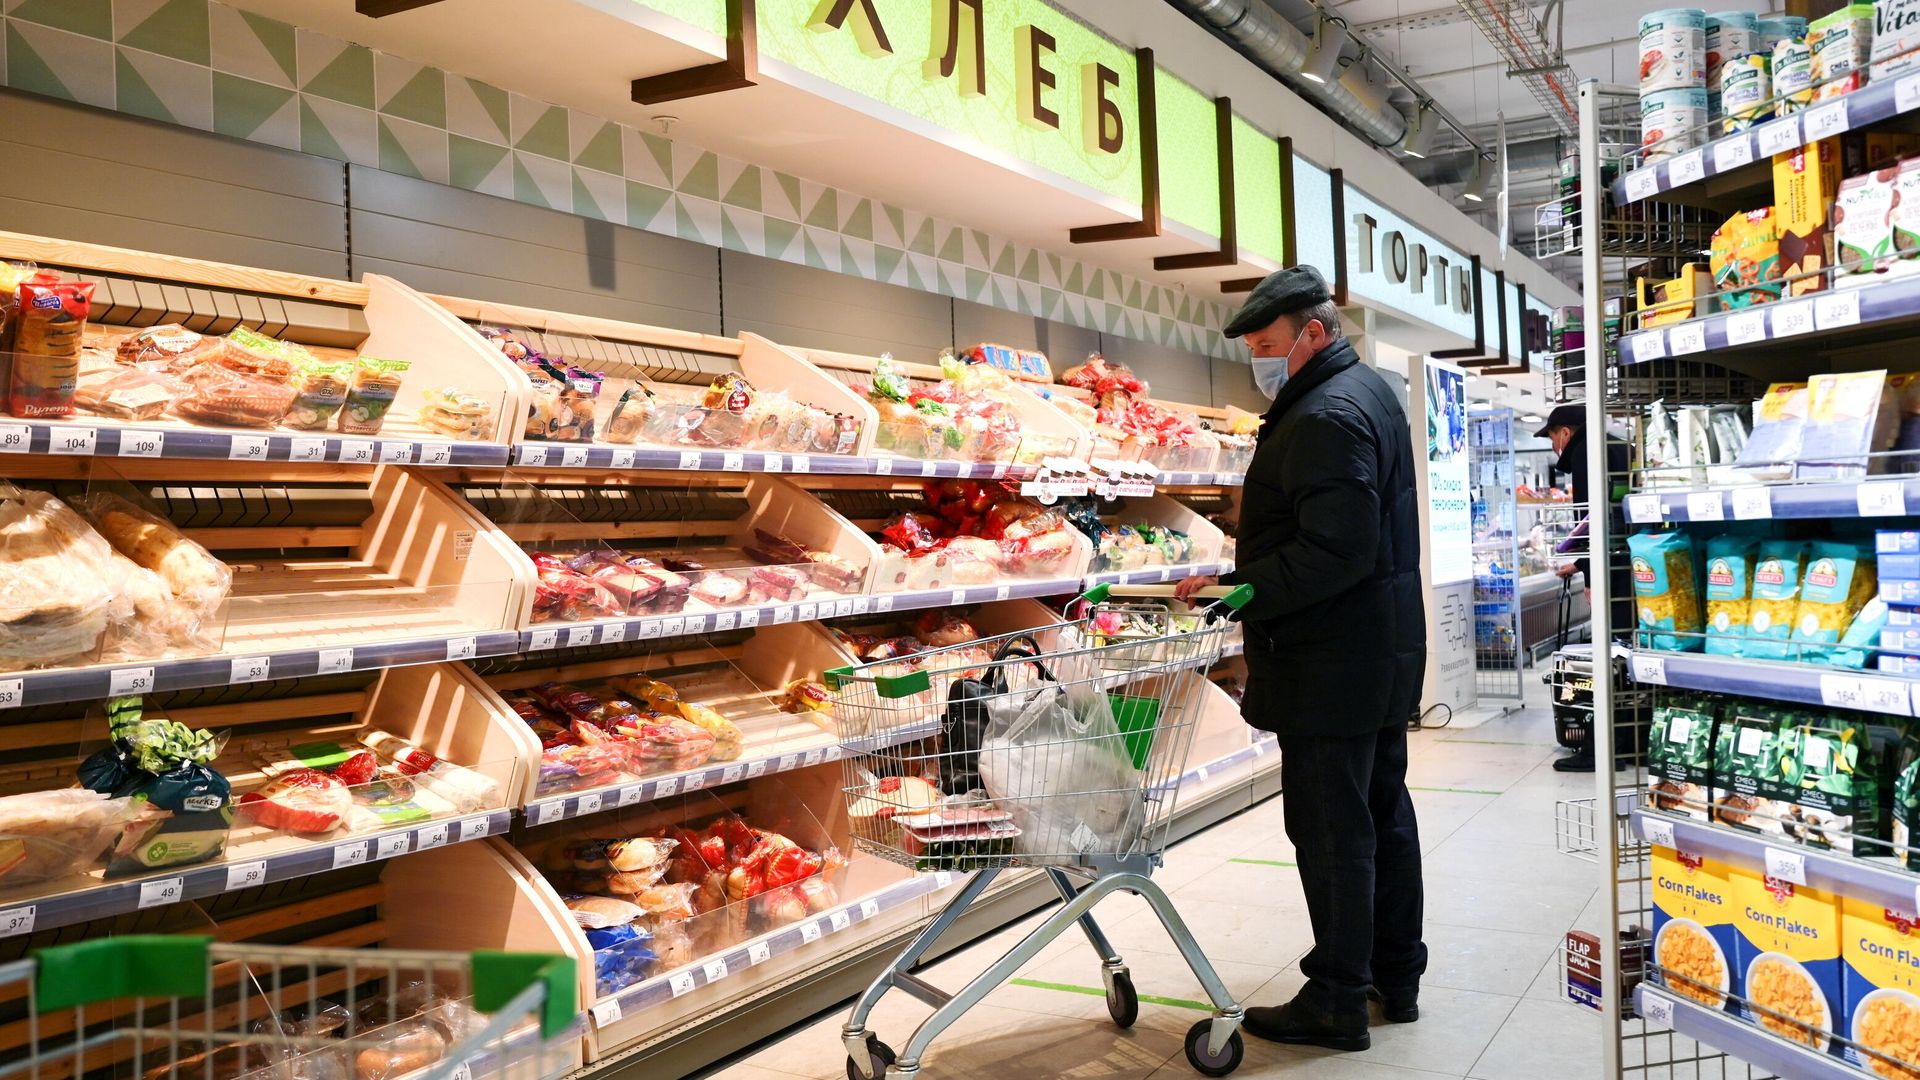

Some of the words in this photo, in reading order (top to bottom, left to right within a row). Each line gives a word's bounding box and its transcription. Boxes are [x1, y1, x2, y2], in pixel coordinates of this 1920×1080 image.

[1876, 6, 1920, 37] Vita
[1820, 113, 1838, 129] 124
[1774, 129, 1791, 144] 114
[1353, 212, 1472, 315] ТОРТЫ
[24, 404, 69, 416] Рулет
[5, 433, 20, 445] 89
[65, 438, 86, 449] 104
[135, 441, 155, 452] 109
[248, 446, 261, 455] 39
[308, 447, 319, 456] 31
[355, 450, 367, 459] 33
[395, 450, 406, 459] 31
[435, 452, 445, 461] 27
[533, 455, 542, 463] 27
[574, 456, 583, 464] 24
[650, 625, 658, 634] 55
[671, 624, 680, 632] 57
[579, 634, 589, 642] 47
[612, 630, 621, 638] 47
[543, 637, 552, 645] 41
[461, 646, 470, 654] 41
[335, 657, 346, 666] 41
[250, 667, 262, 677] 53
[132, 678, 145, 689] 53
[1836, 690, 1856, 704] 164
[1879, 691, 1900, 704] 279
[629, 792, 637, 801] 45
[589, 800, 598, 809] 45
[551, 807, 560, 816] 45
[474, 823, 484, 833] 55
[432, 833, 442, 843] 54
[393, 840, 404, 850] 67
[350, 849, 362, 859] 47
[1779, 860, 1796, 874] 359
[246, 870, 258, 881] 59
[161, 887, 175, 897] 49
[1658, 876, 1683, 893] Corn
[1686, 885, 1723, 905] Flakes
[9, 917, 25, 929] 37
[1745, 907, 1773, 926] Corn
[1776, 917, 1818, 939] Flakes
[1568, 938, 1591, 956] FLAP
[1859, 937, 1894, 960] Corn
[1897, 949, 1920, 968] Fla
[1652, 1004, 1666, 1019] 289
